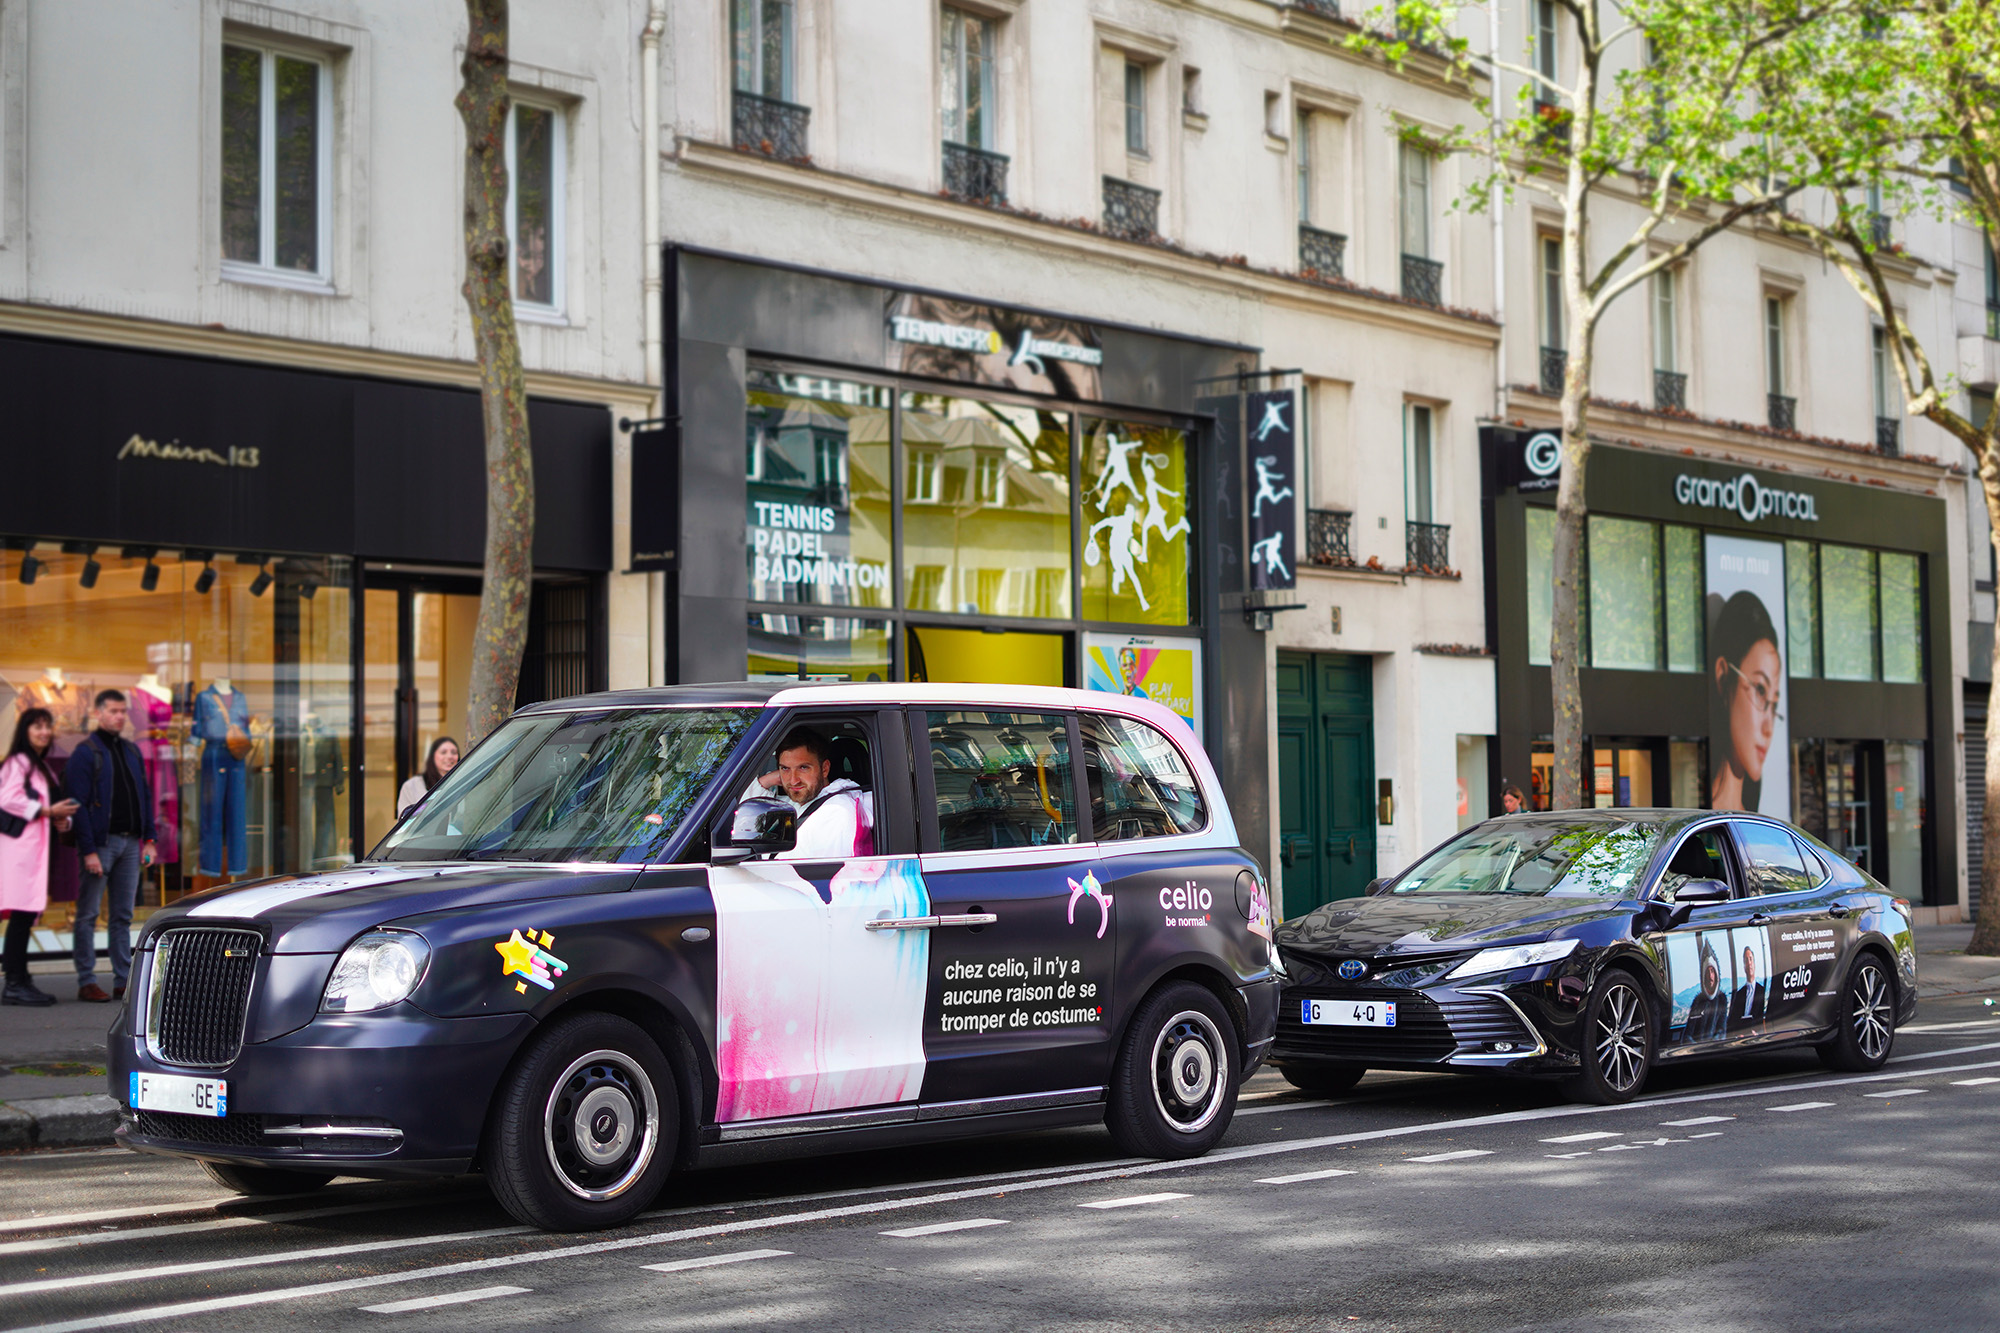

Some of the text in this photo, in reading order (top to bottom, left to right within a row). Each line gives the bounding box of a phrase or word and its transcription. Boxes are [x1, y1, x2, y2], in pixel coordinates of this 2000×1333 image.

[754, 501, 836, 532] TENNIS
[754, 528, 829, 558] PADEL
[754, 556, 889, 588] BADMINTON
[1149, 682, 1173, 697] PLAY
[1159, 880, 1213, 910] celio
[1165, 916, 1177, 927] be
[945, 957, 1080, 980] chez celio, il n'y a
[1783, 965, 1812, 989] celio
[942, 981, 1097, 1006] aucune raison de se
[941, 1009, 1006, 1034] tromper
[1009, 1009, 1029, 1027] de
[1311, 1004, 1321, 1020] G
[141, 1079, 149, 1103] F
[217, 1099, 226, 1112] 75
